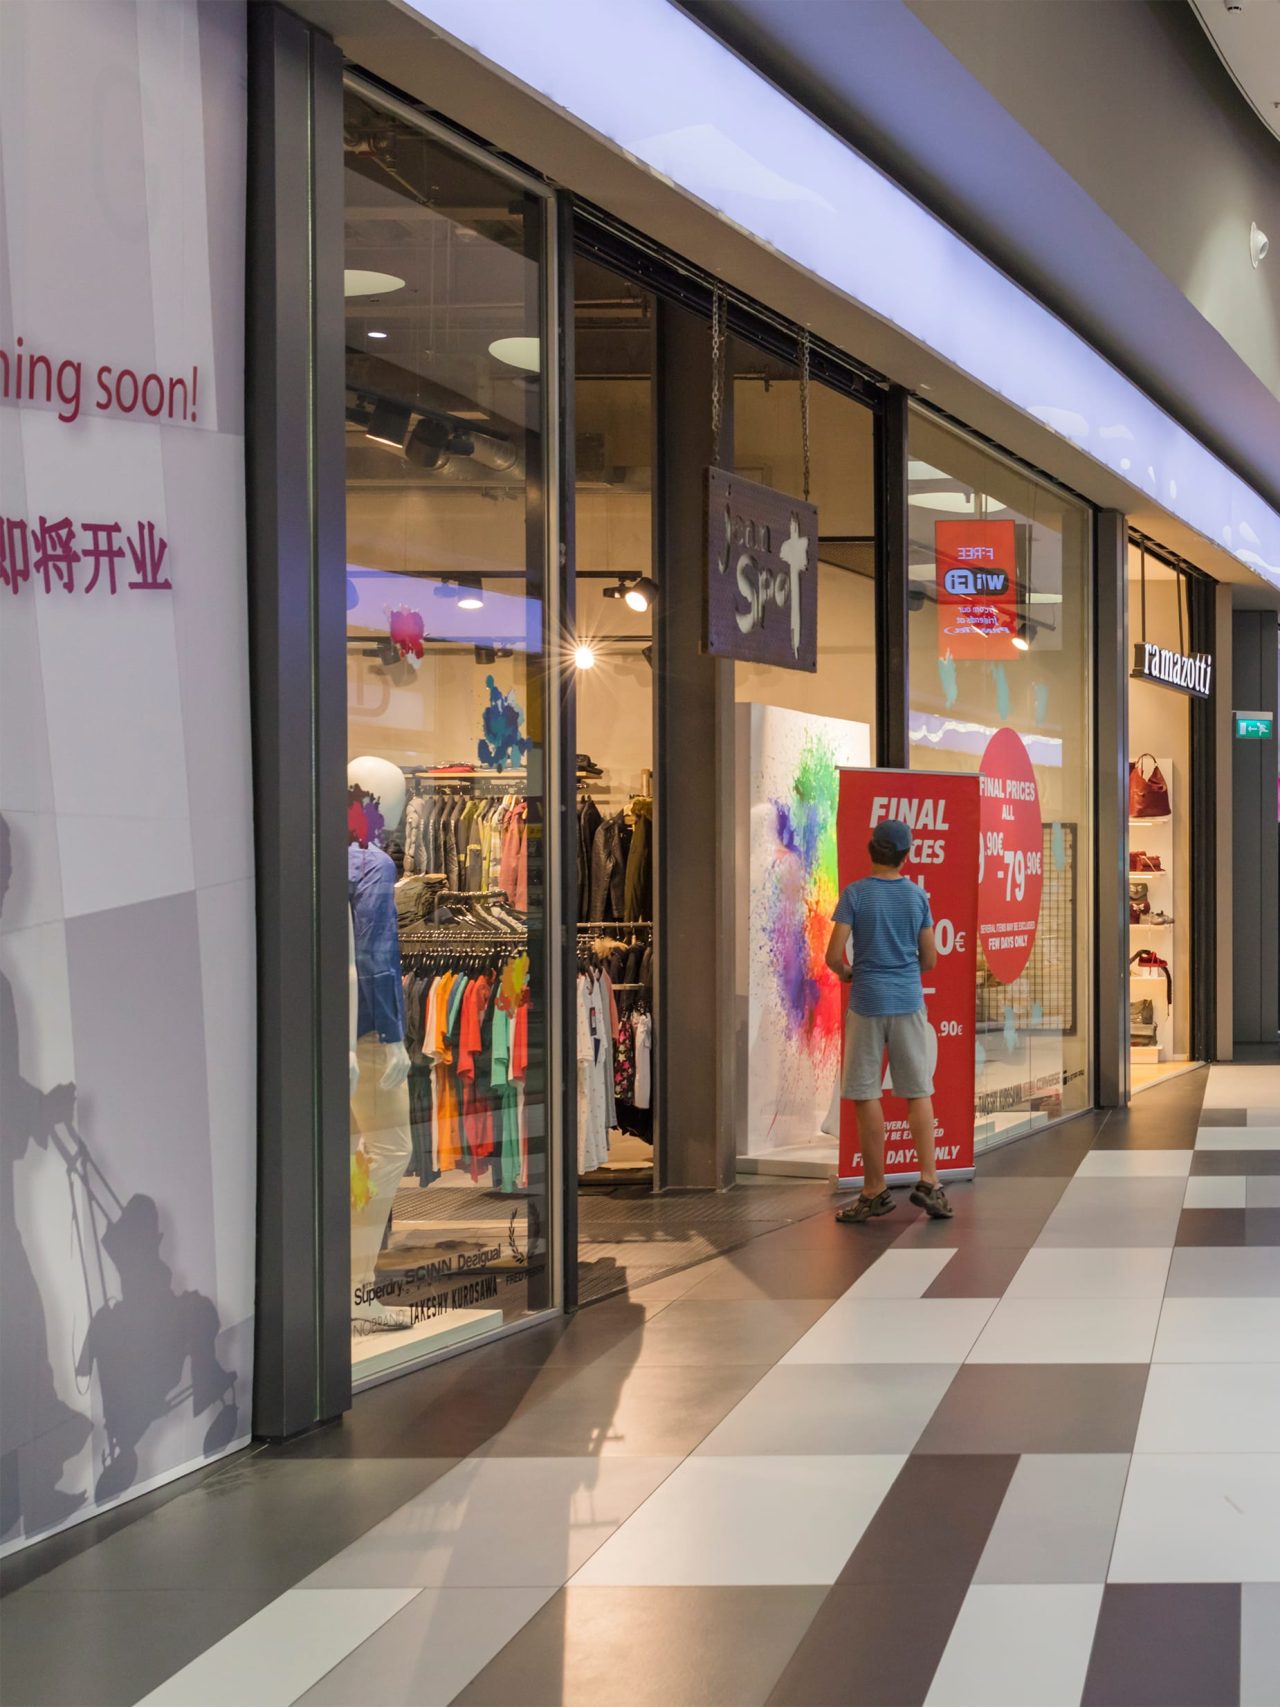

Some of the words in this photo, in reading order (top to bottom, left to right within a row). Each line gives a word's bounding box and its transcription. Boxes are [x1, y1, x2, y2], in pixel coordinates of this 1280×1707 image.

[96, 365, 198, 422] soon!
[0, 515, 172, 595] 即将开业
[735, 510, 809, 660] Spot
[1144, 643, 1212, 695] ramazotti
[869, 796, 949, 831] FINAL
[980, 777, 1005, 799] FINAL
[1006, 779, 1036, 802] PRICES
[1001, 804, 1015, 821] ALL
[886, 1148, 919, 1165] DAYS
[935, 1145, 960, 1160] NLY
[409, 1292, 450, 1326] TAKESHY
[451, 1274, 498, 1311] KUROSAWA
